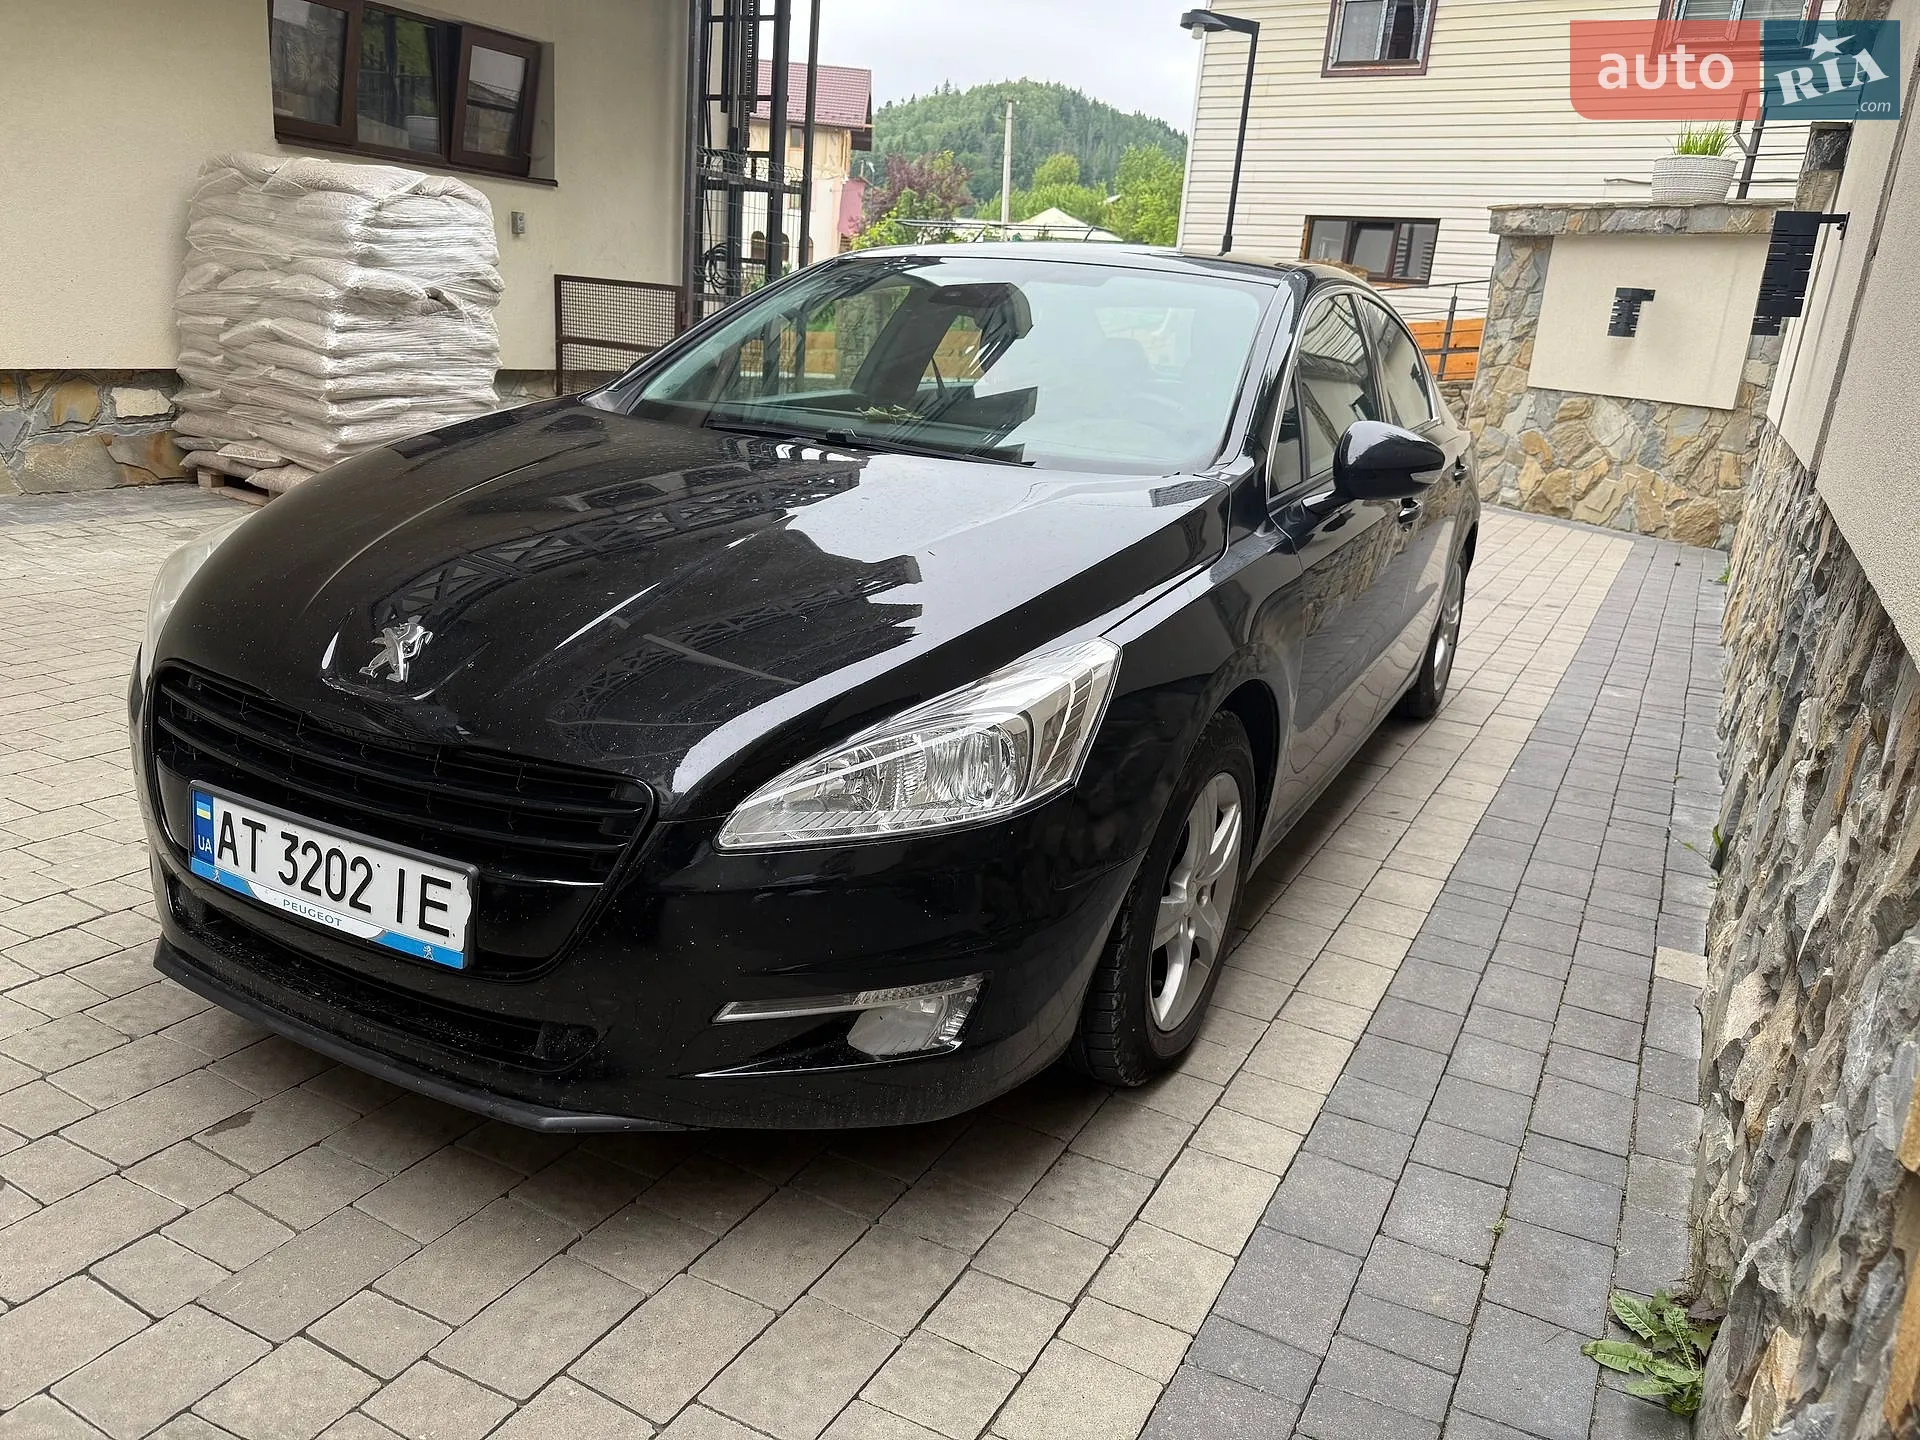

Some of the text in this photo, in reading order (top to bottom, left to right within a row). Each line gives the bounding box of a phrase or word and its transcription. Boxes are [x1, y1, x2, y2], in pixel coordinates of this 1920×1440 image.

[198, 834, 212, 854] UA
[217, 811, 451, 938] AT 3202 IE
[283, 899, 342, 927] PEUGEOT
